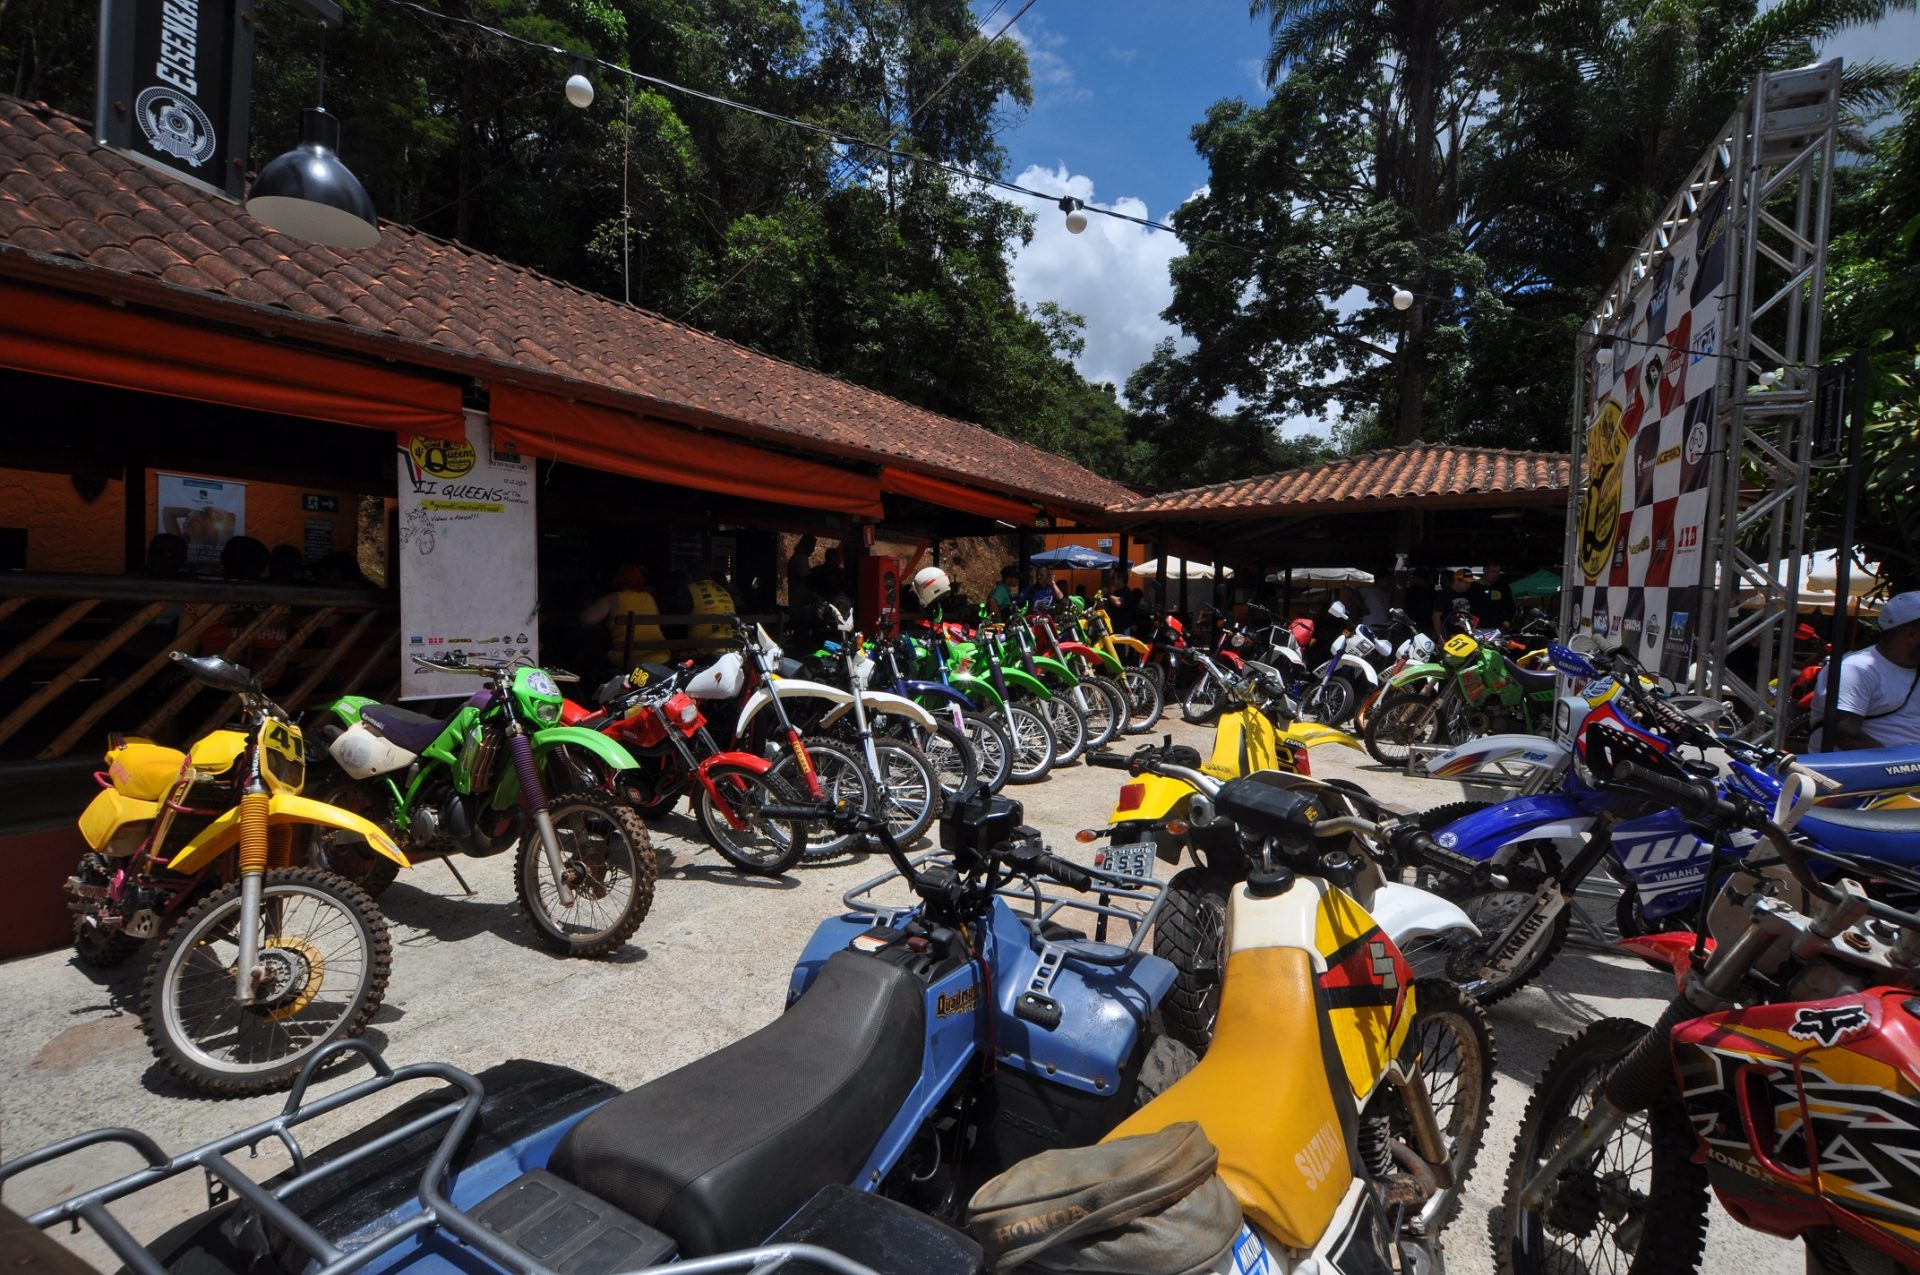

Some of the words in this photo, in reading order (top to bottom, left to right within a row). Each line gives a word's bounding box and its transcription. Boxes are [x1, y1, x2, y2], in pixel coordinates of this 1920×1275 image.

[442, 484, 503, 501] QUEENS
[1447, 637, 1469, 652] 51
[1558, 660, 1583, 673] CIRCUIT
[269, 725, 302, 758] 41
[1884, 763, 1920, 776] YAMA
[1740, 774, 1769, 799] CIRCUIT
[1103, 854, 1145, 871] GSS
[1655, 866, 1700, 882] YAMAHA
[1294, 1120, 1342, 1192] SUZUKI
[995, 1203, 1090, 1241] HONDA
